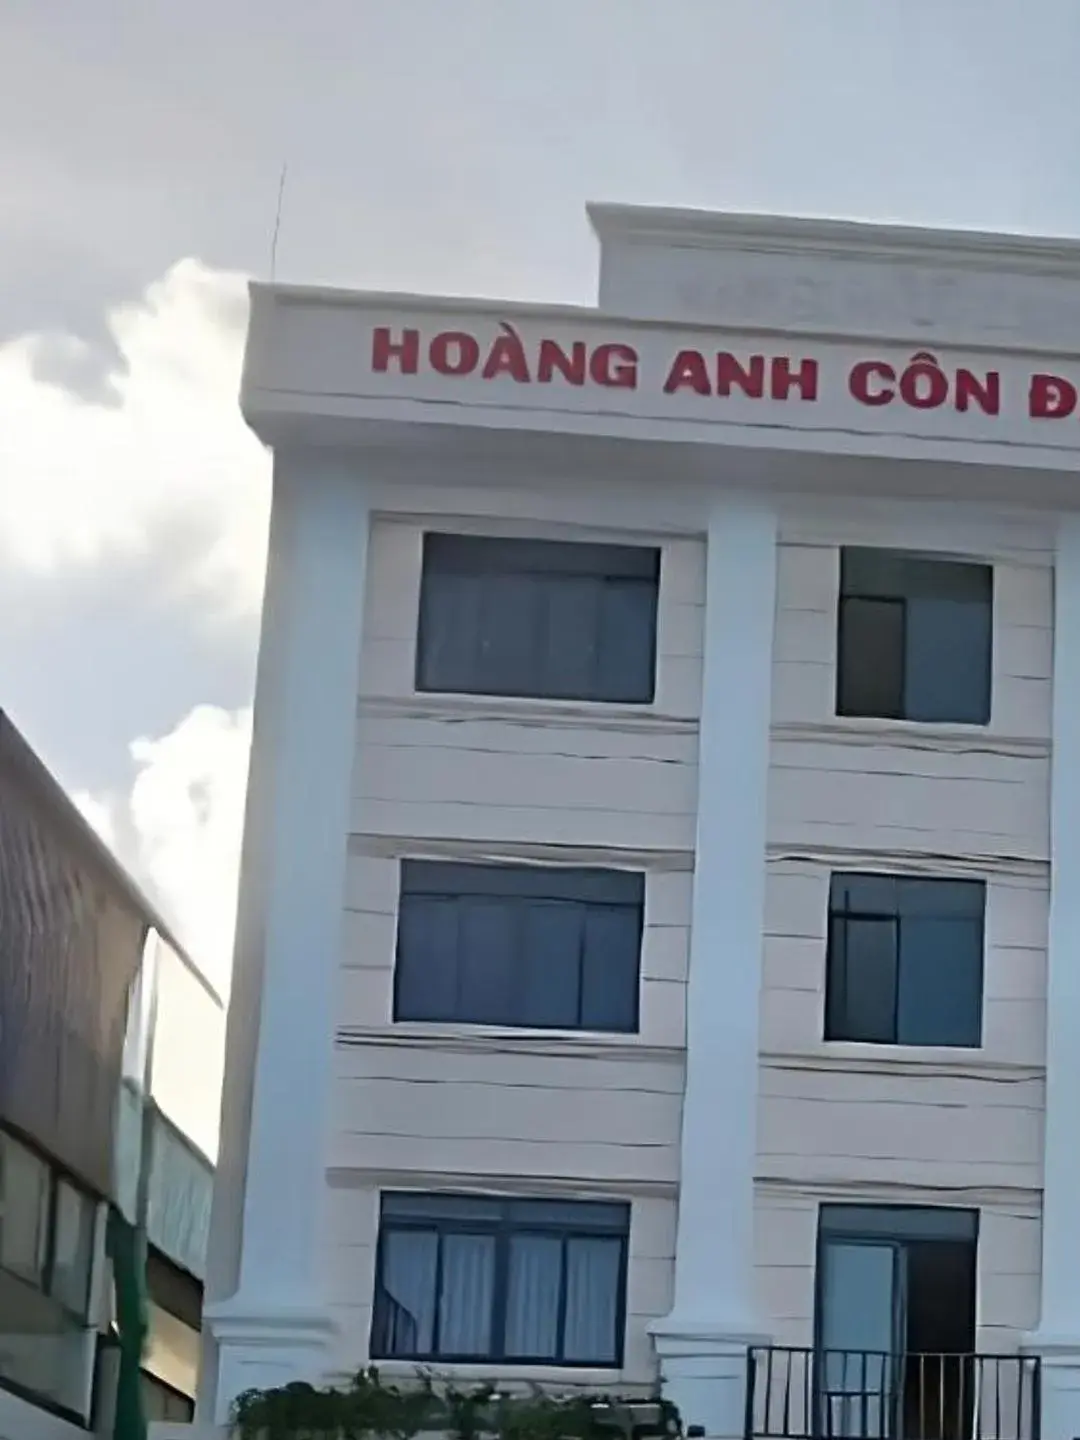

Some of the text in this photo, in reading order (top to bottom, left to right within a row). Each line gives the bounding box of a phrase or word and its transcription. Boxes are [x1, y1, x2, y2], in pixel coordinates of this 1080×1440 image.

[371, 322, 639, 389] HOÀNG
[663, 350, 818, 402] ANH
[849, 353, 1000, 416] CÔN
